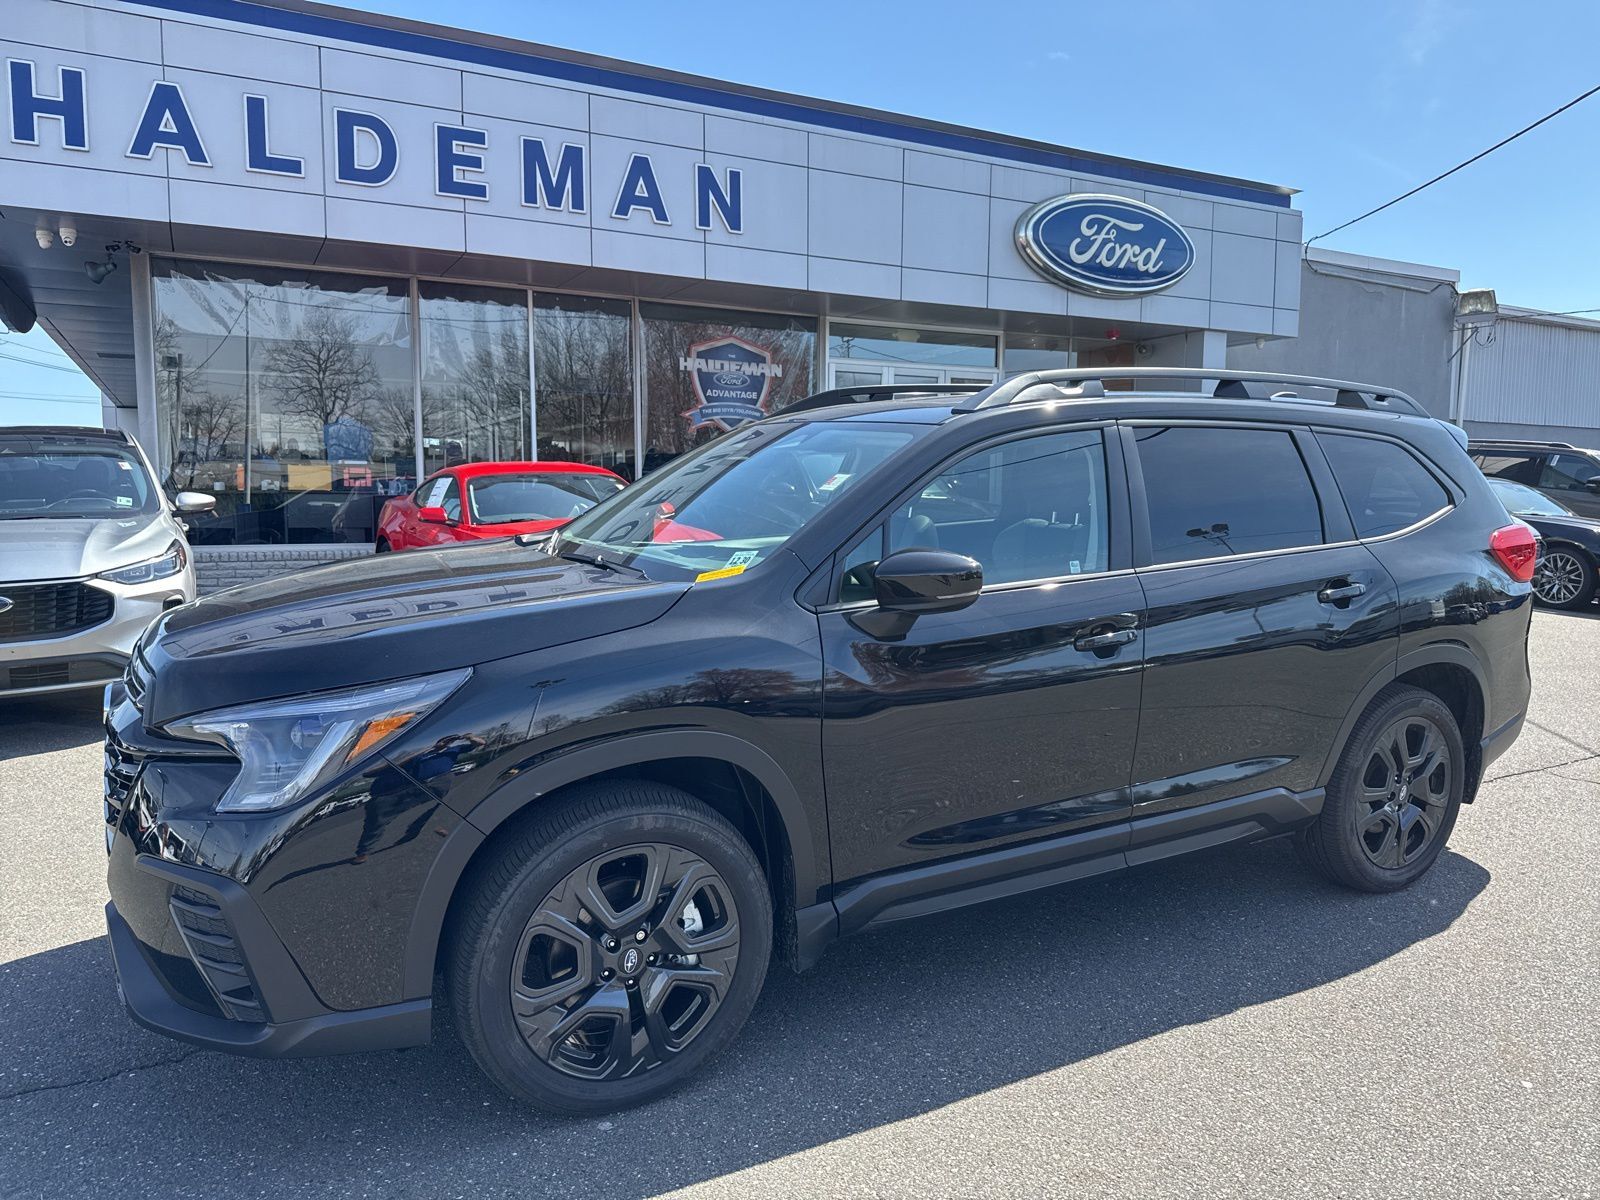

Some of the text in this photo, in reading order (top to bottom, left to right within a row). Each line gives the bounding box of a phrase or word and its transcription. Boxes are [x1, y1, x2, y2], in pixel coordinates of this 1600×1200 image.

[6, 57, 743, 234] HALDEMAN
[1069, 213, 1167, 274] Ford
[680, 357, 782, 377] HALDEMAN
[720, 374, 742, 385] Ford
[706, 389, 758, 399] ADVANTAGE
